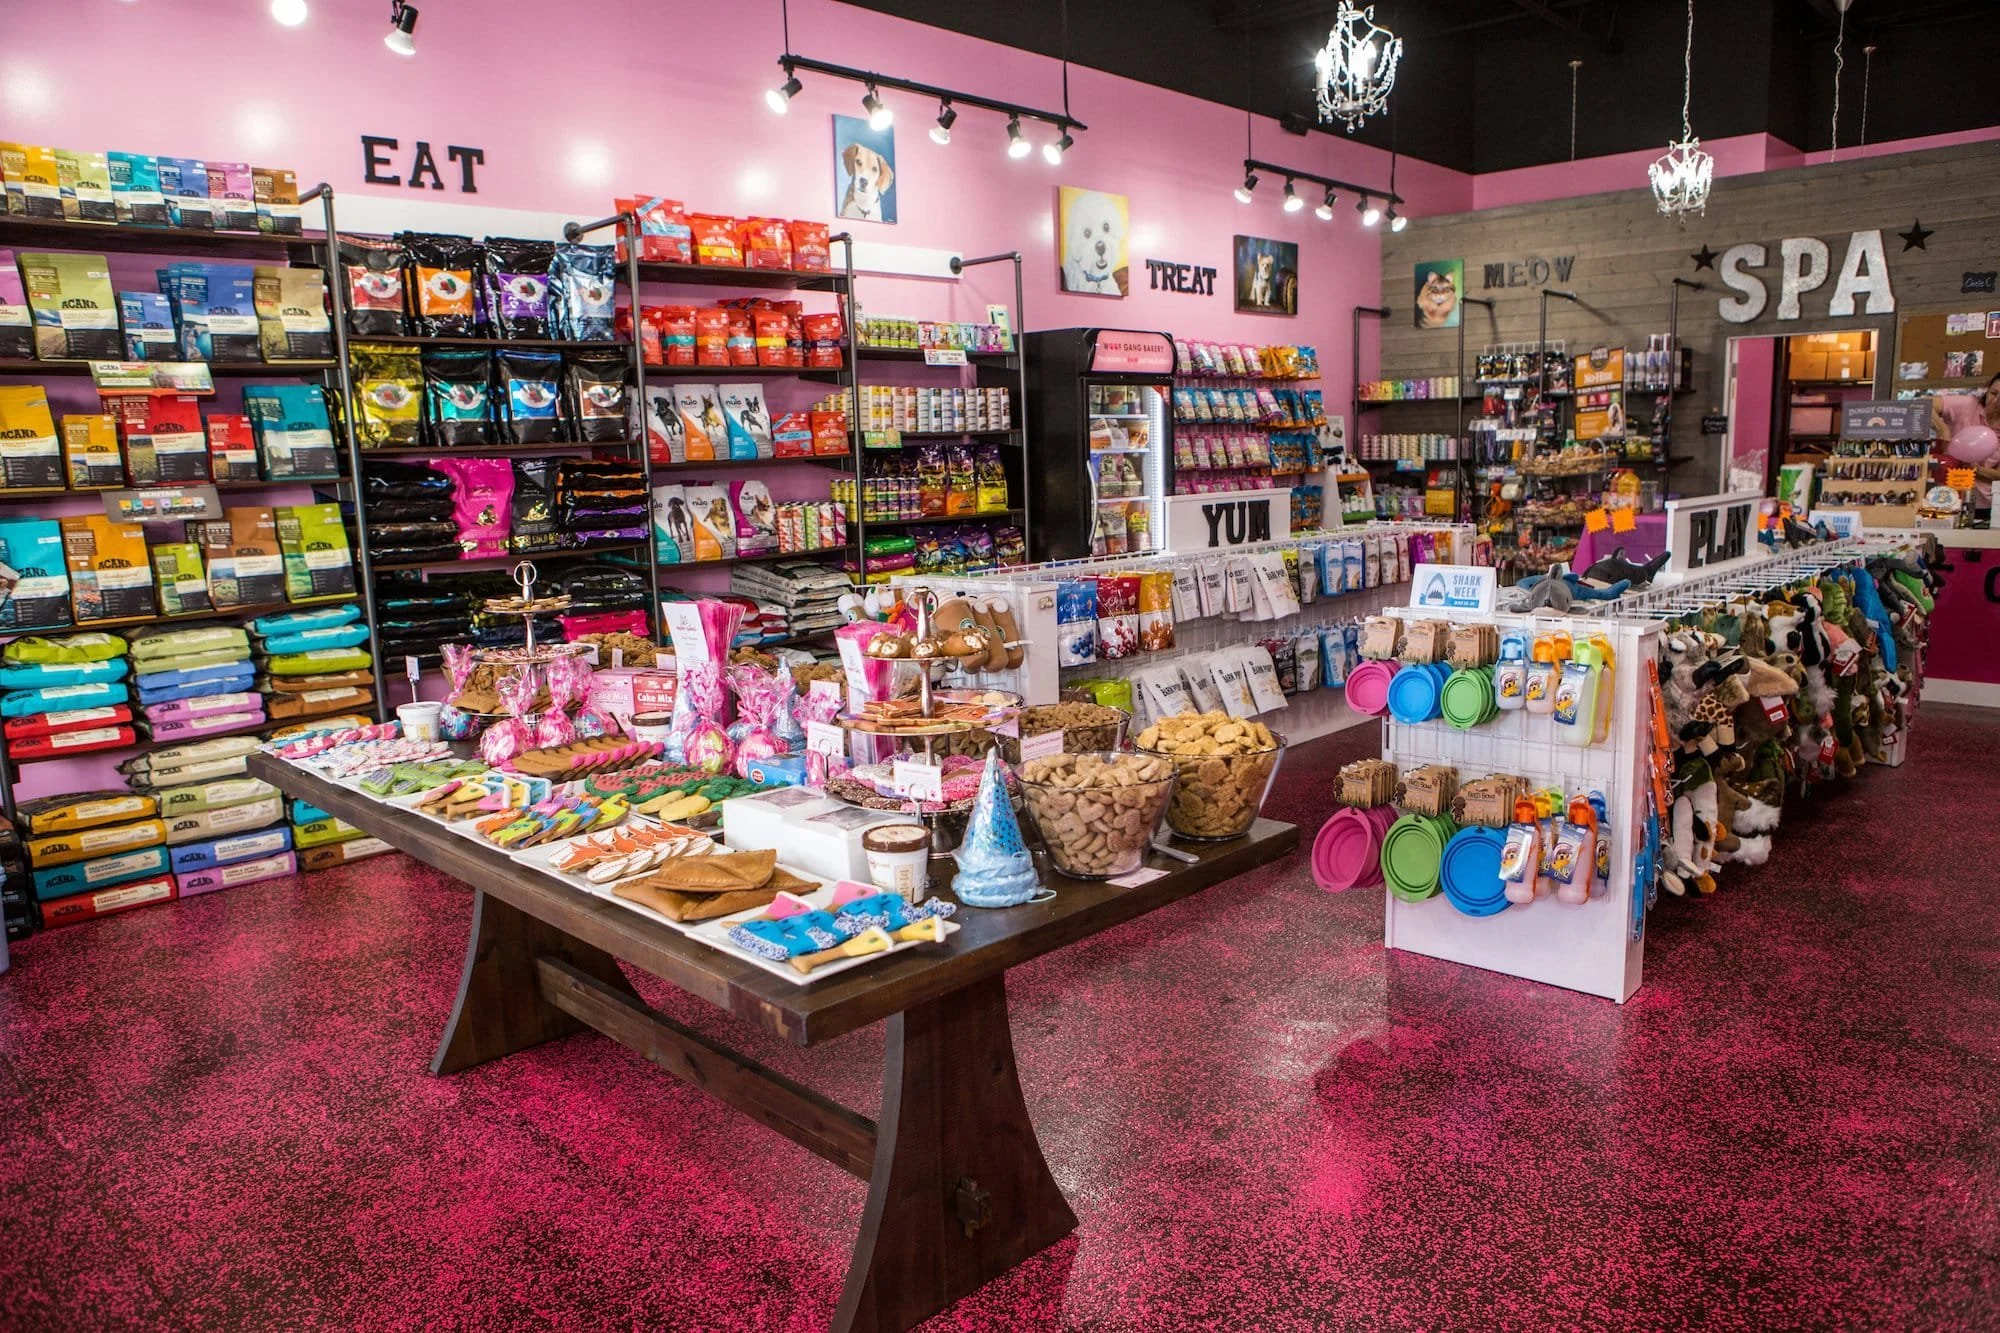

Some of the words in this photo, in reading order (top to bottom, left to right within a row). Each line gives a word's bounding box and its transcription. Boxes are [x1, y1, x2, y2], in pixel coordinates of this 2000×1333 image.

[361, 135, 485, 193] EAT
[1145, 258, 1217, 296] TREAT
[1484, 255, 1575, 289] MEOW
[1718, 229, 1896, 324] SPA
[61, 298, 98, 310] ACANA
[208, 305, 240, 316] ACANA
[282, 306, 312, 317] ACANA
[1123, 344, 1141, 352] GANG
[1143, 345, 1164, 353] BAKERY
[1876, 406, 1908, 416] CHEWS
[0, 427, 37, 440] ACANA
[153, 422, 186, 434] ACANA
[139, 490, 182, 499] HERITAGE
[1202, 499, 1271, 548] YUM
[1687, 504, 1753, 569] PLAY
[305, 542, 335, 552] ACANA
[98, 558, 132, 570] ACANA
[17, 568, 48, 579] CANA
[1452, 575, 1482, 587] SHARK
[1454, 587, 1477, 598] WEEK
[637, 693, 657, 703] Cake
[657, 694, 673, 703] Mix
[170, 793, 198, 805] ACANA
[173, 819, 200, 832] ACANA
[40, 843, 71, 857] ACANA
[179, 852, 207, 864] ACANA
[46, 874, 76, 889] ACANA
[186, 876, 214, 889] ACANA
[52, 904, 84, 918] ACANA
